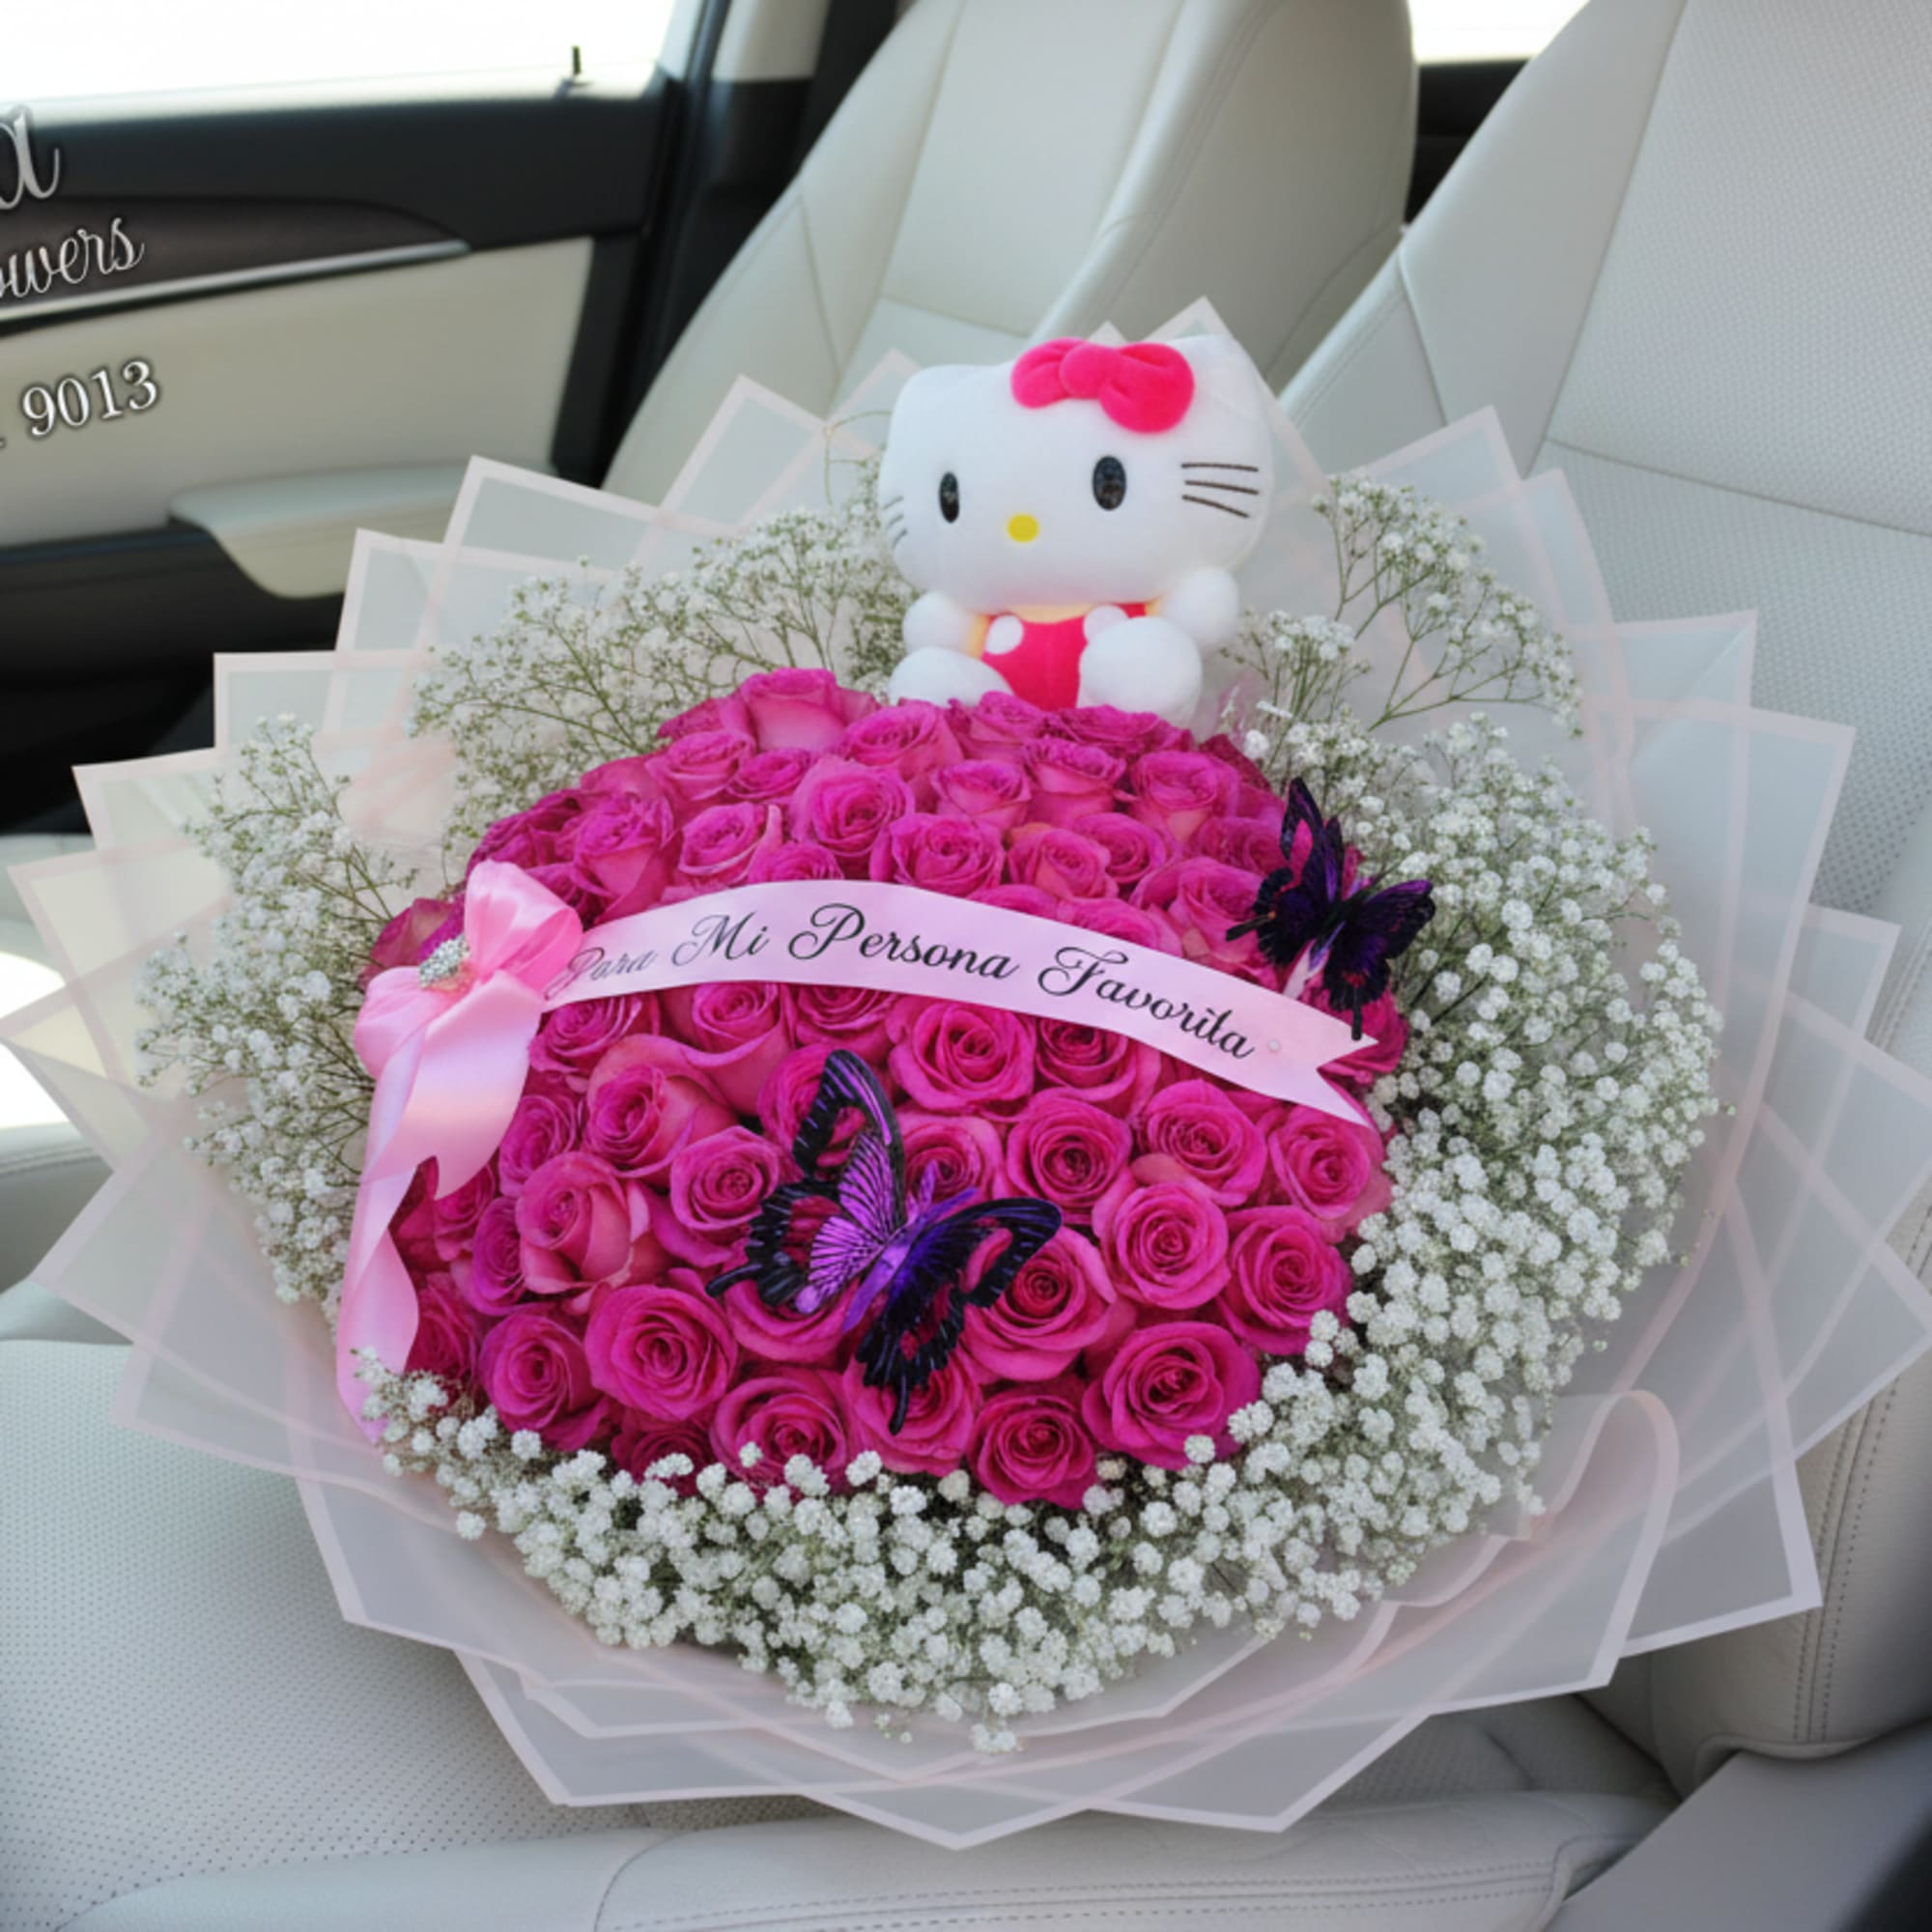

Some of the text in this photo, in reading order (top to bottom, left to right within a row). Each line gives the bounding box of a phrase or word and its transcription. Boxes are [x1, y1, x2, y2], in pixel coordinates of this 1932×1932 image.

[545, 903, 1256, 1060] Para Mi Persona Favorita
